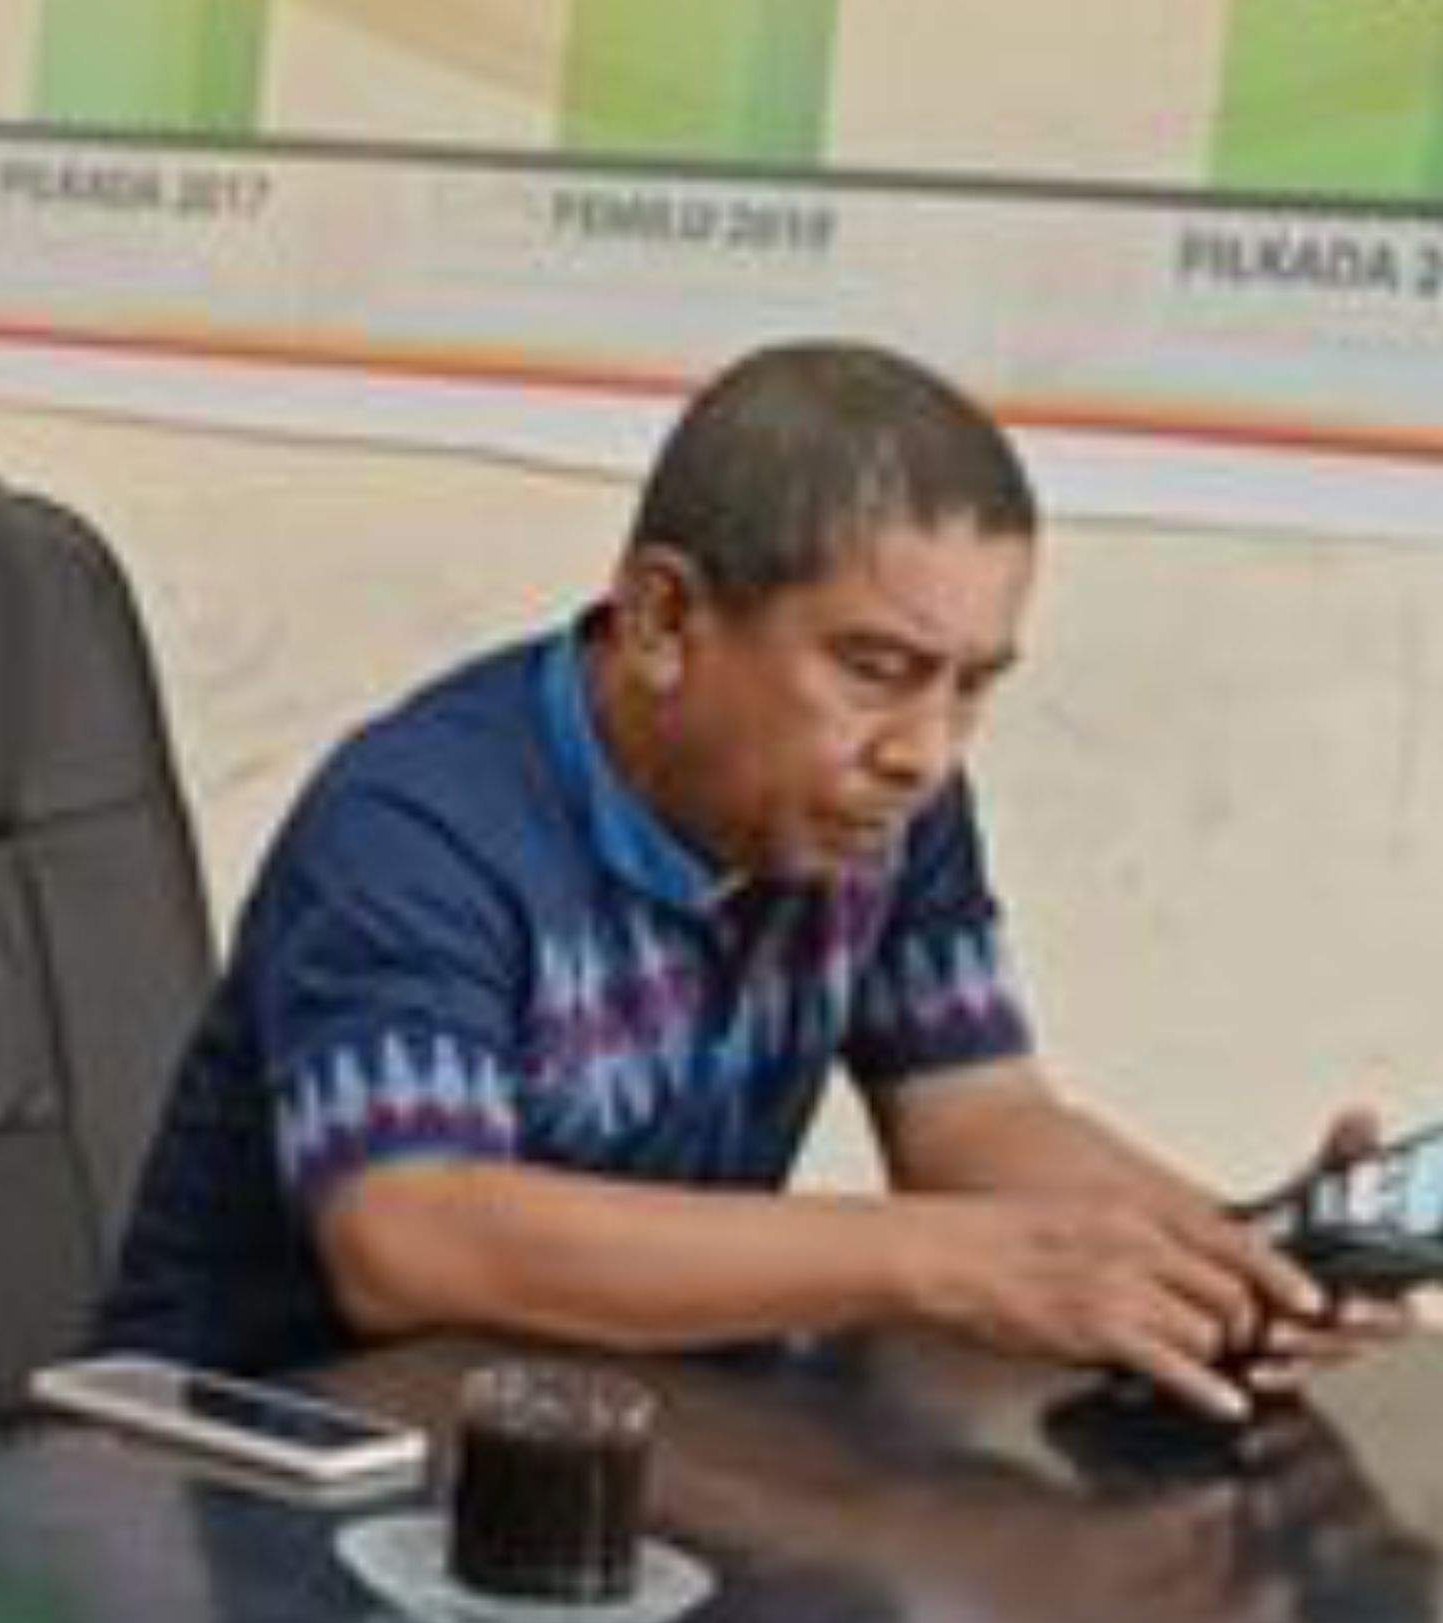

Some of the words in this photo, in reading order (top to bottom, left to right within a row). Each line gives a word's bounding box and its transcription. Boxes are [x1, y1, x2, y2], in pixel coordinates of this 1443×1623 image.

[0, 158, 161, 210] PILKADA
[175, 172, 272, 222] 2017
[1179, 226, 1399, 294] PILKADA
